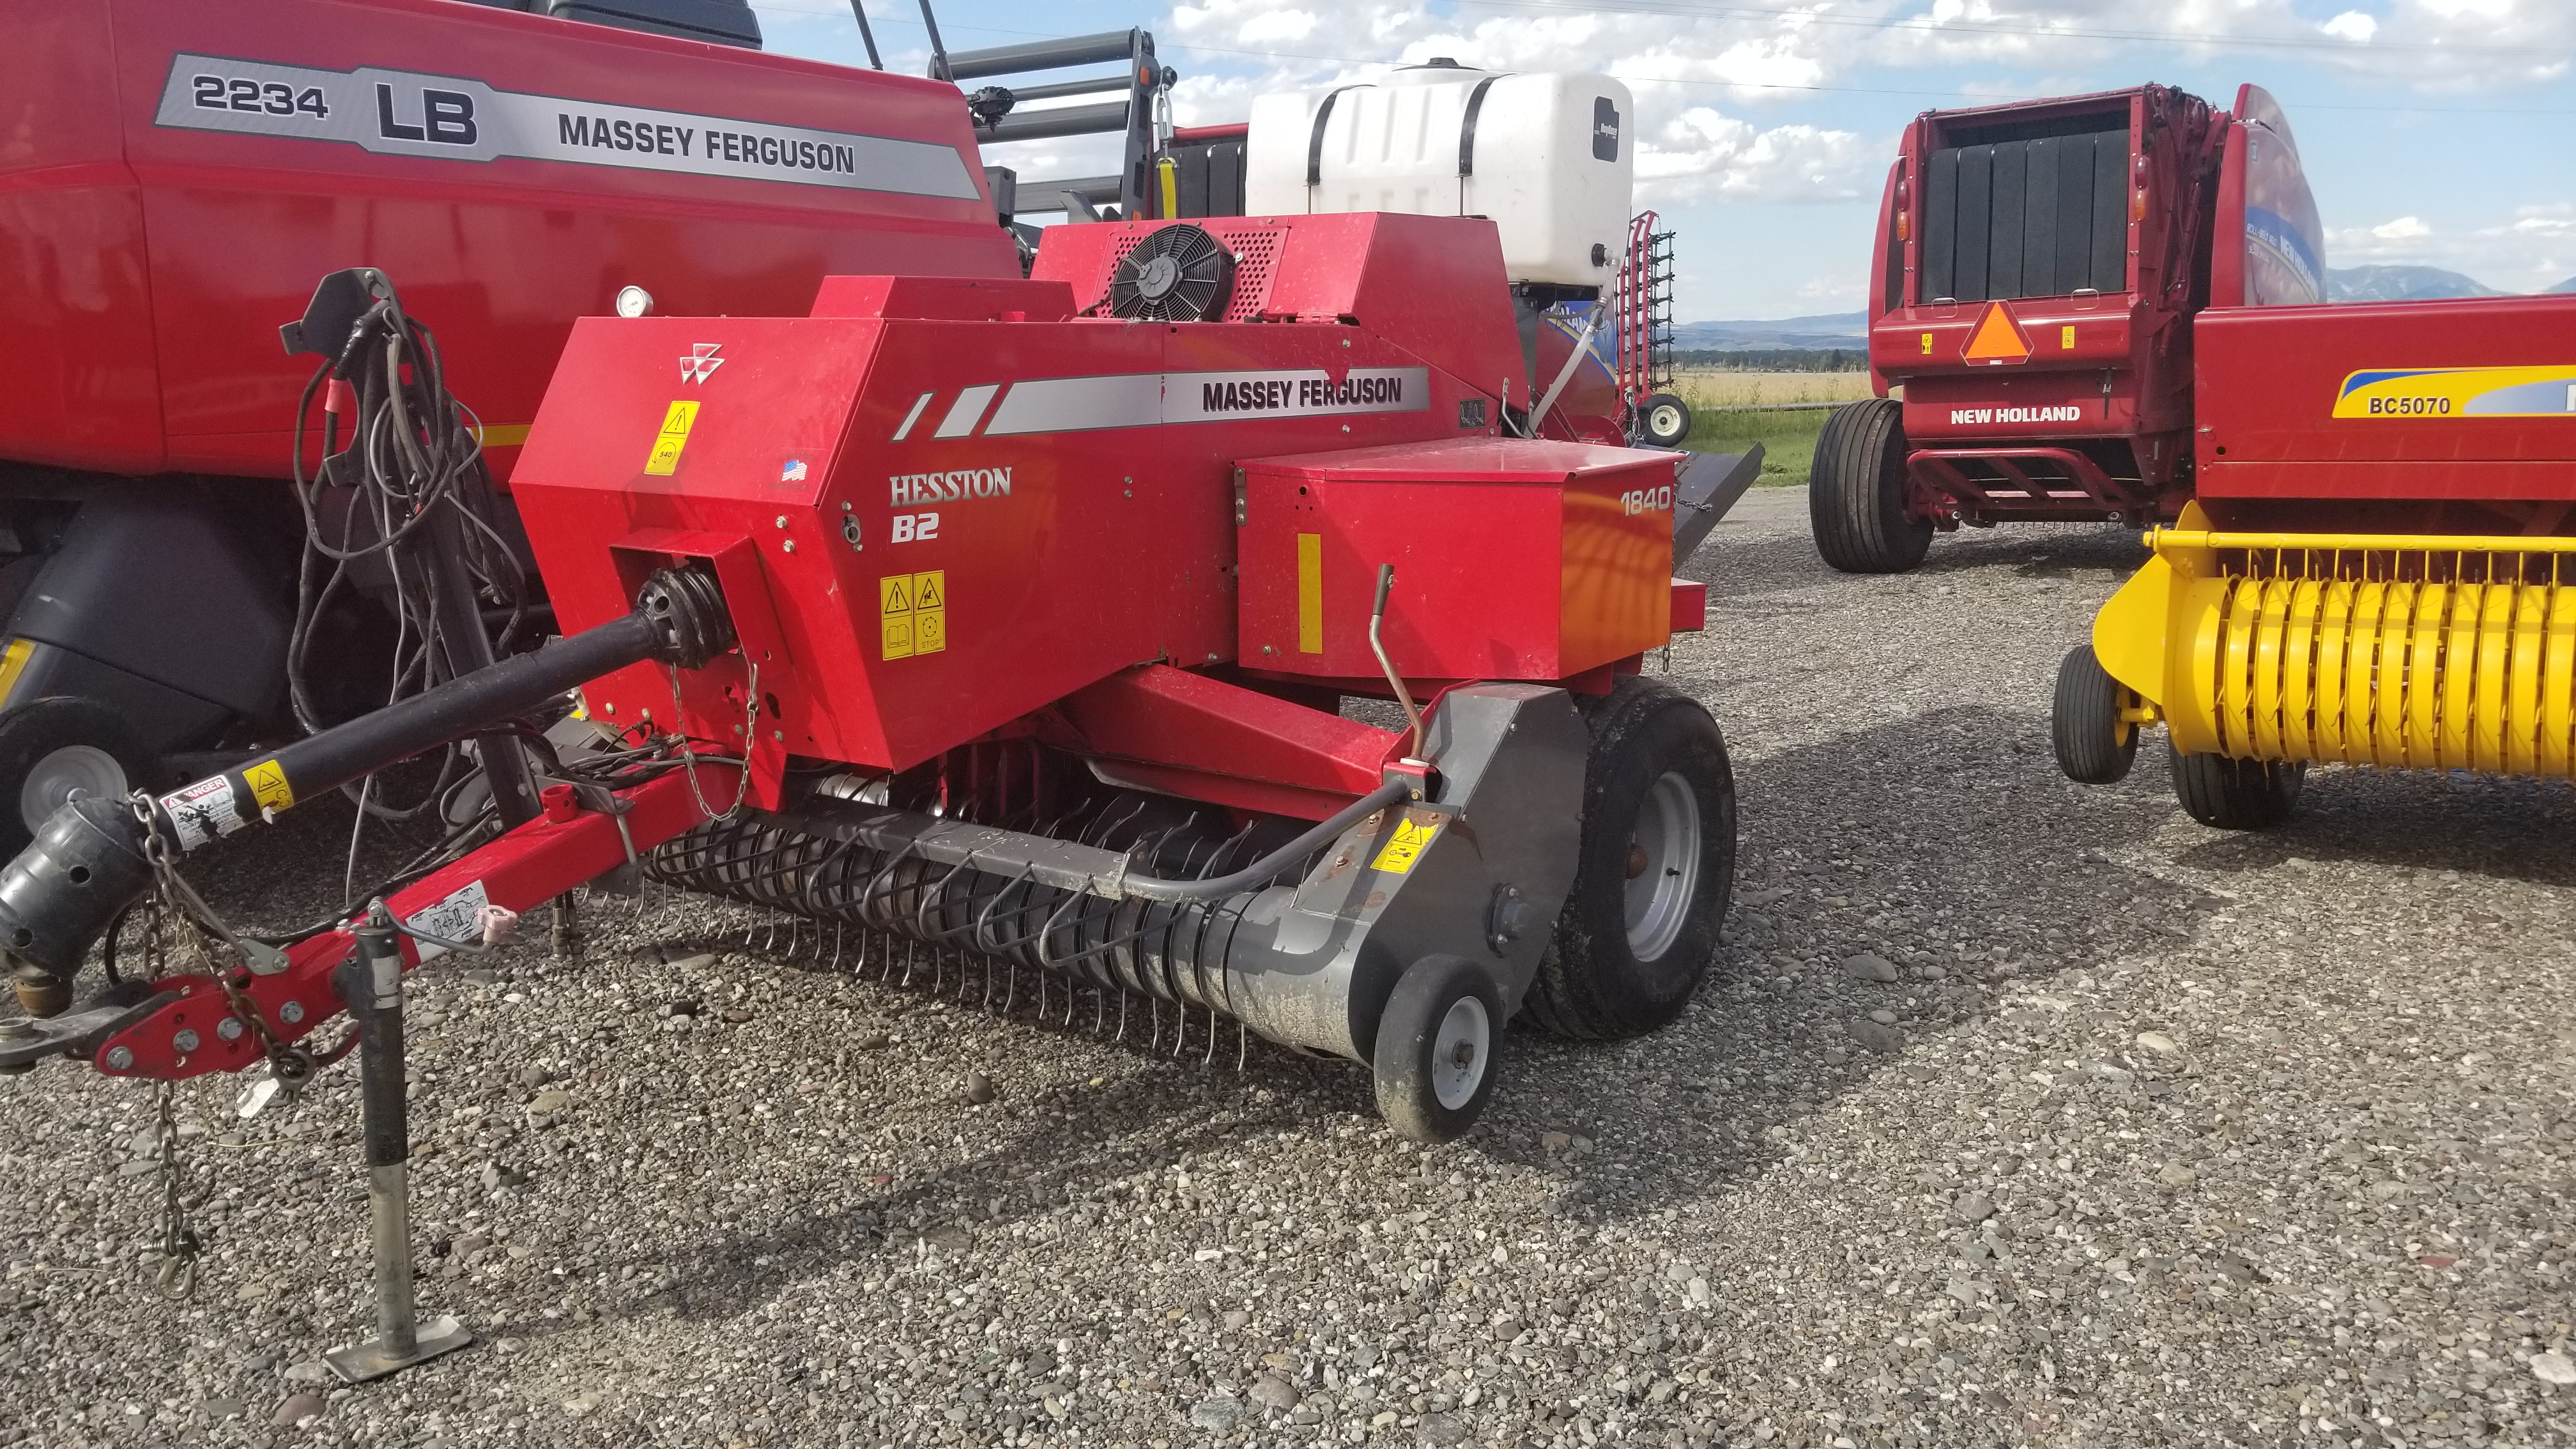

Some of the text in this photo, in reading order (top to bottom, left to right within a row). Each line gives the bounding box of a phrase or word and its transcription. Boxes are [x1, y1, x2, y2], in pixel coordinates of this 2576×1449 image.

[192, 74, 478, 146] 2234 LB
[558, 113, 855, 175] MASSEY FERGUSON
[1202, 378, 1402, 413] MASSEY FERGUSON
[2368, 397, 2450, 415] BC5070
[1951, 406, 2080, 424] NEW HOLLAND
[889, 467, 1012, 508] HESSTON
[1620, 486, 1671, 516] 1840
[891, 512, 939, 543] B2
[921, 639, 939, 648] STOP
[184, 779, 225, 797] ANGER
